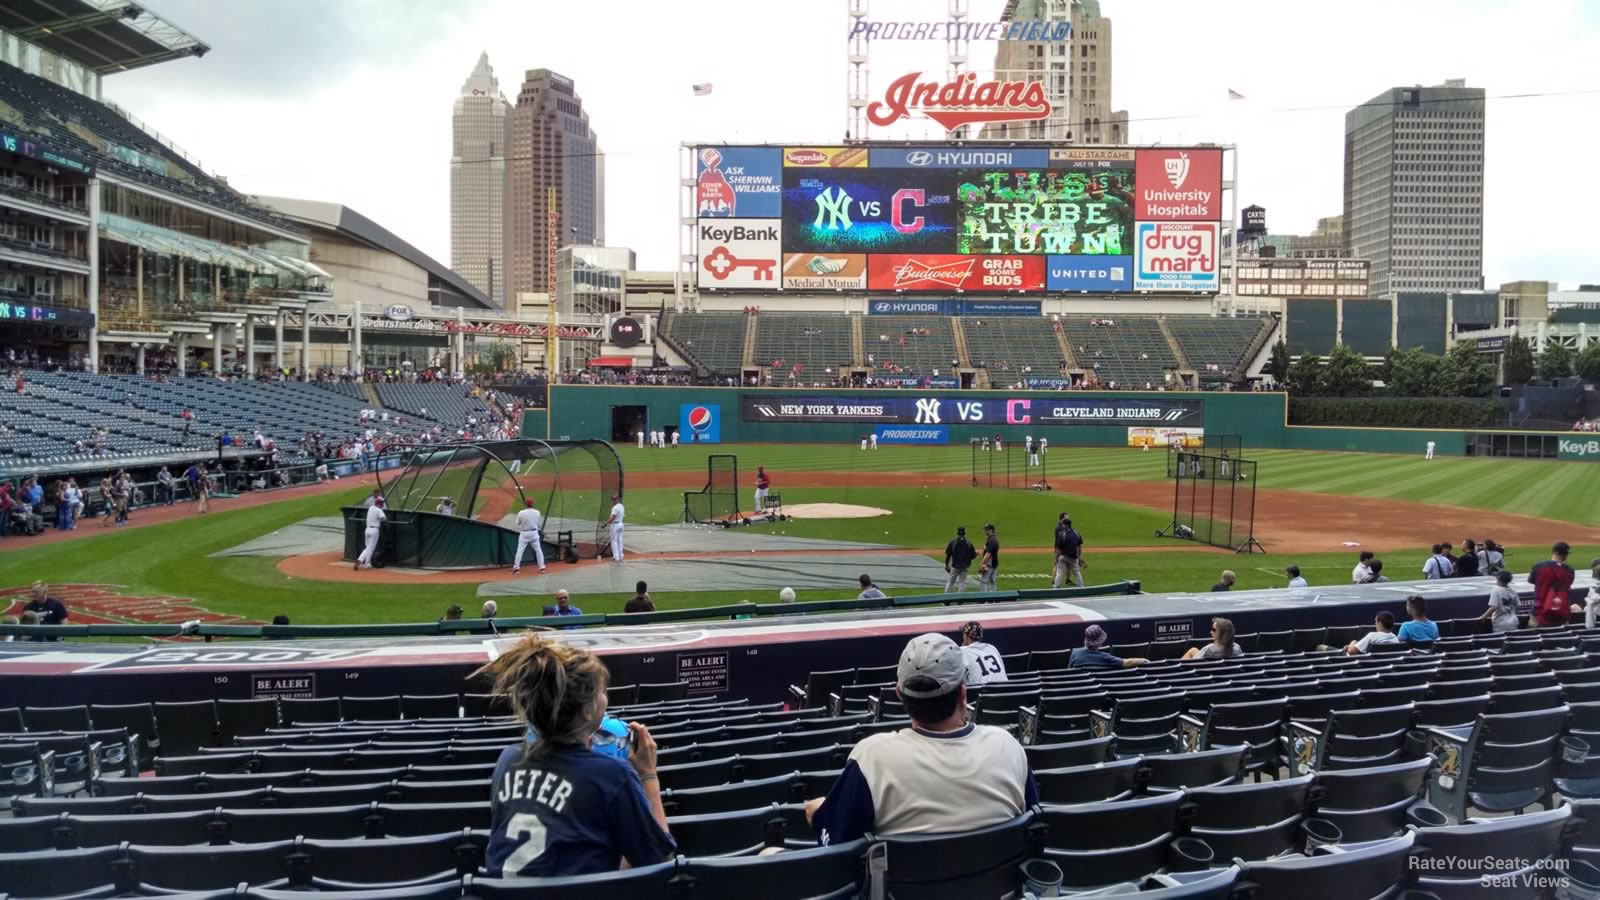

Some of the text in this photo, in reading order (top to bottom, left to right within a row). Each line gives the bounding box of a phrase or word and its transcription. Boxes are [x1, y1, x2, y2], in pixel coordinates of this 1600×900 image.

[850, 21, 1071, 40] PROGRESSIVE FIELD
[867, 72, 1051, 127] Indians
[3, 135, 16, 151] VS
[788, 152, 826, 163] Sugardale
[938, 152, 1012, 164] HYUNDAI
[725, 167, 745, 175] ASK
[728, 176, 773, 184] SHERWIN
[735, 184, 781, 193] WILLIAMS
[1144, 189, 1211, 204] University
[859, 201, 881, 217] VS
[891, 188, 925, 233] C
[984, 203, 1107, 224] TRIBE
[1147, 203, 1208, 218] Hospitals
[701, 226, 778, 243] KeyBank
[1145, 224, 1202, 256] drug
[987, 232, 1105, 254] TOWN
[983, 259, 1023, 269] GRAB
[1151, 254, 1212, 272] mart
[893, 265, 972, 281] Budweiser
[1052, 269, 1107, 278] UNITED
[788, 277, 862, 288] Medical Mutual
[983, 276, 1022, 286] BUDS
[1181, 282, 1217, 290] Drugstore
[14, 305, 26, 318] VS
[32, 306, 43, 321] C
[893, 303, 938, 311] HYUNDAI
[781, 404, 803, 415] NEW
[805, 405, 834, 415] YORK
[836, 405, 883, 416] YANKEES
[957, 402, 983, 421] VS
[1007, 399, 1031, 424] C
[1053, 407, 1113, 418] CLEVELAND
[1117, 408, 1161, 418] INDIANS
[690, 433, 710, 441] ppsi
[881, 429, 941, 439] PROGRESSIVE
[1559, 440, 1600, 455] KeyB
[1158, 624, 1191, 633] BE ALERT
[681, 656, 725, 667] BE ALERT
[976, 655, 1001, 677] 13
[213, 676, 228, 684] 150
[344, 672, 359, 680] 149
[257, 679, 310, 689] BE ALERT
[498, 769, 573, 813] JETER
[502, 812, 547, 880] 2
